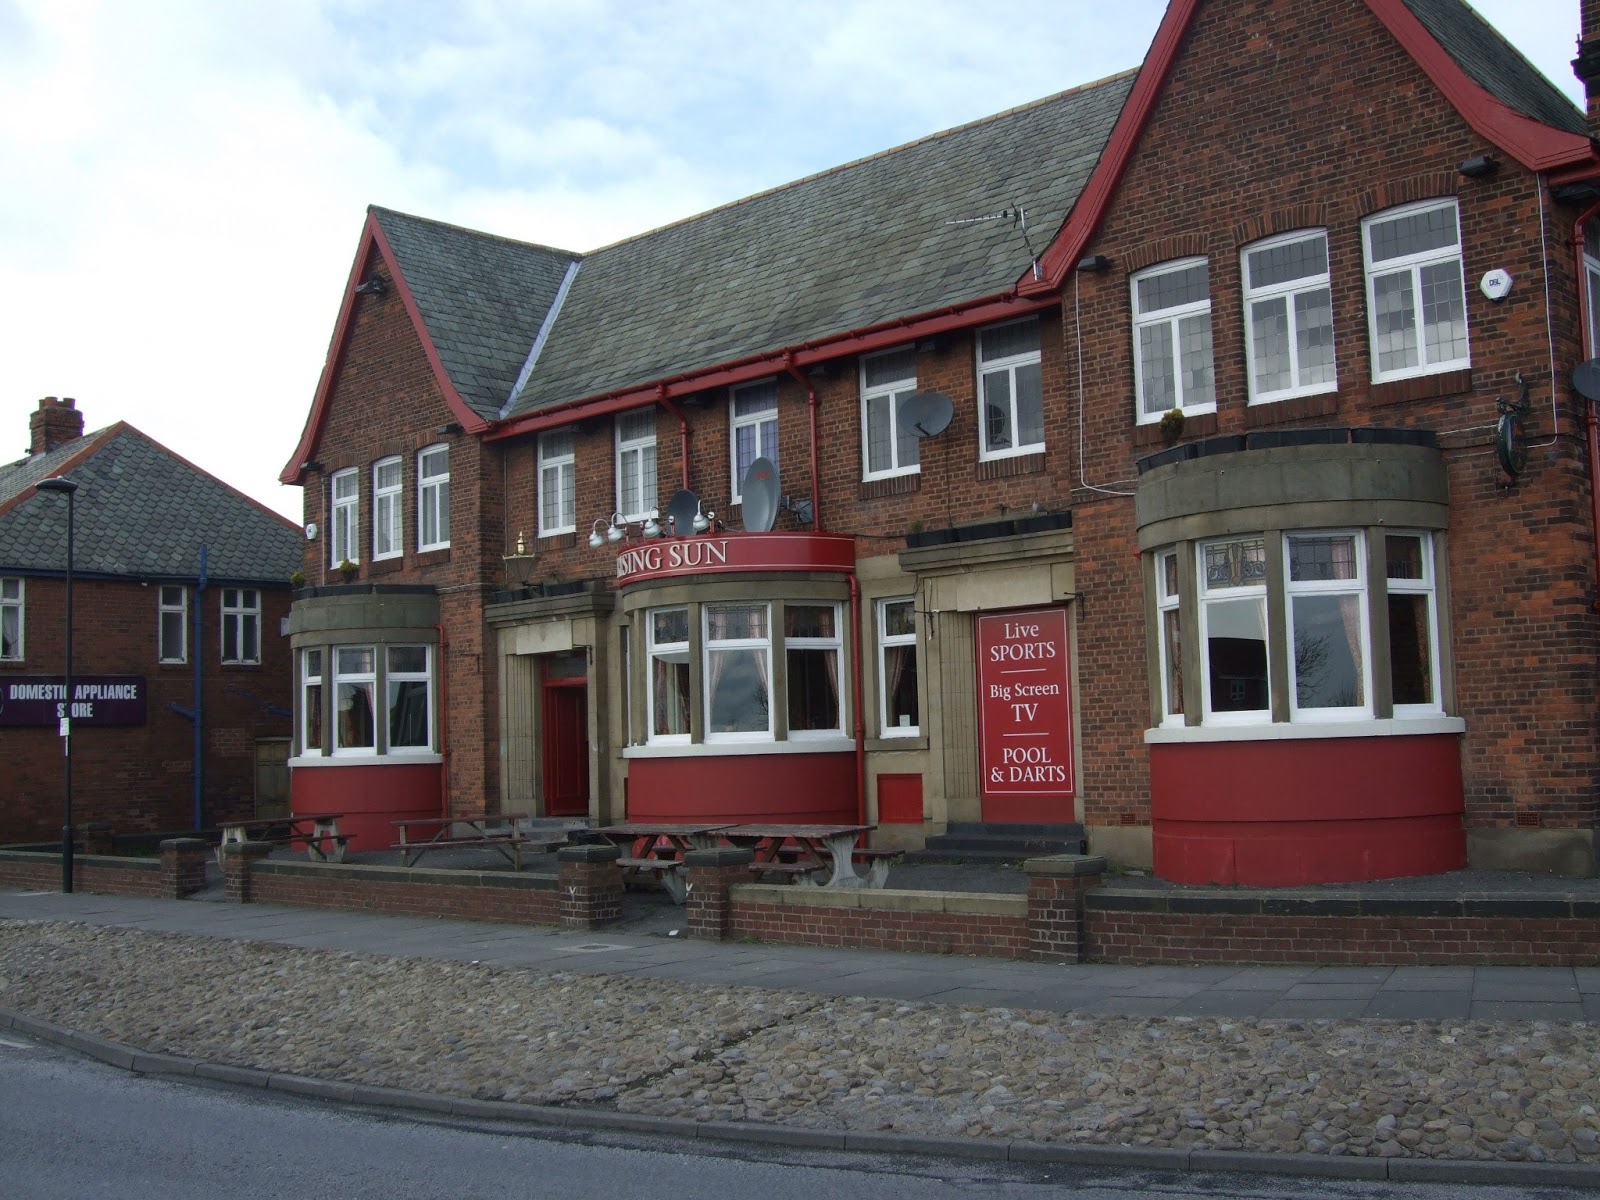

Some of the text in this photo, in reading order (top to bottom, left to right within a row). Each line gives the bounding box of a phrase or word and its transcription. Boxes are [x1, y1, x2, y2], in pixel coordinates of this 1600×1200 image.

[669, 541, 728, 567] SUN
[1004, 623, 1039, 639] Live
[990, 641, 1056, 662] SPORTS
[74, 684, 137, 700] APPLIANCE
[990, 682, 1060, 701] Big Screen
[56, 702, 93, 718] SORE
[1010, 703, 1039, 722] TV
[1003, 747, 1052, 764] POOL
[990, 765, 1066, 782] & DARTS
